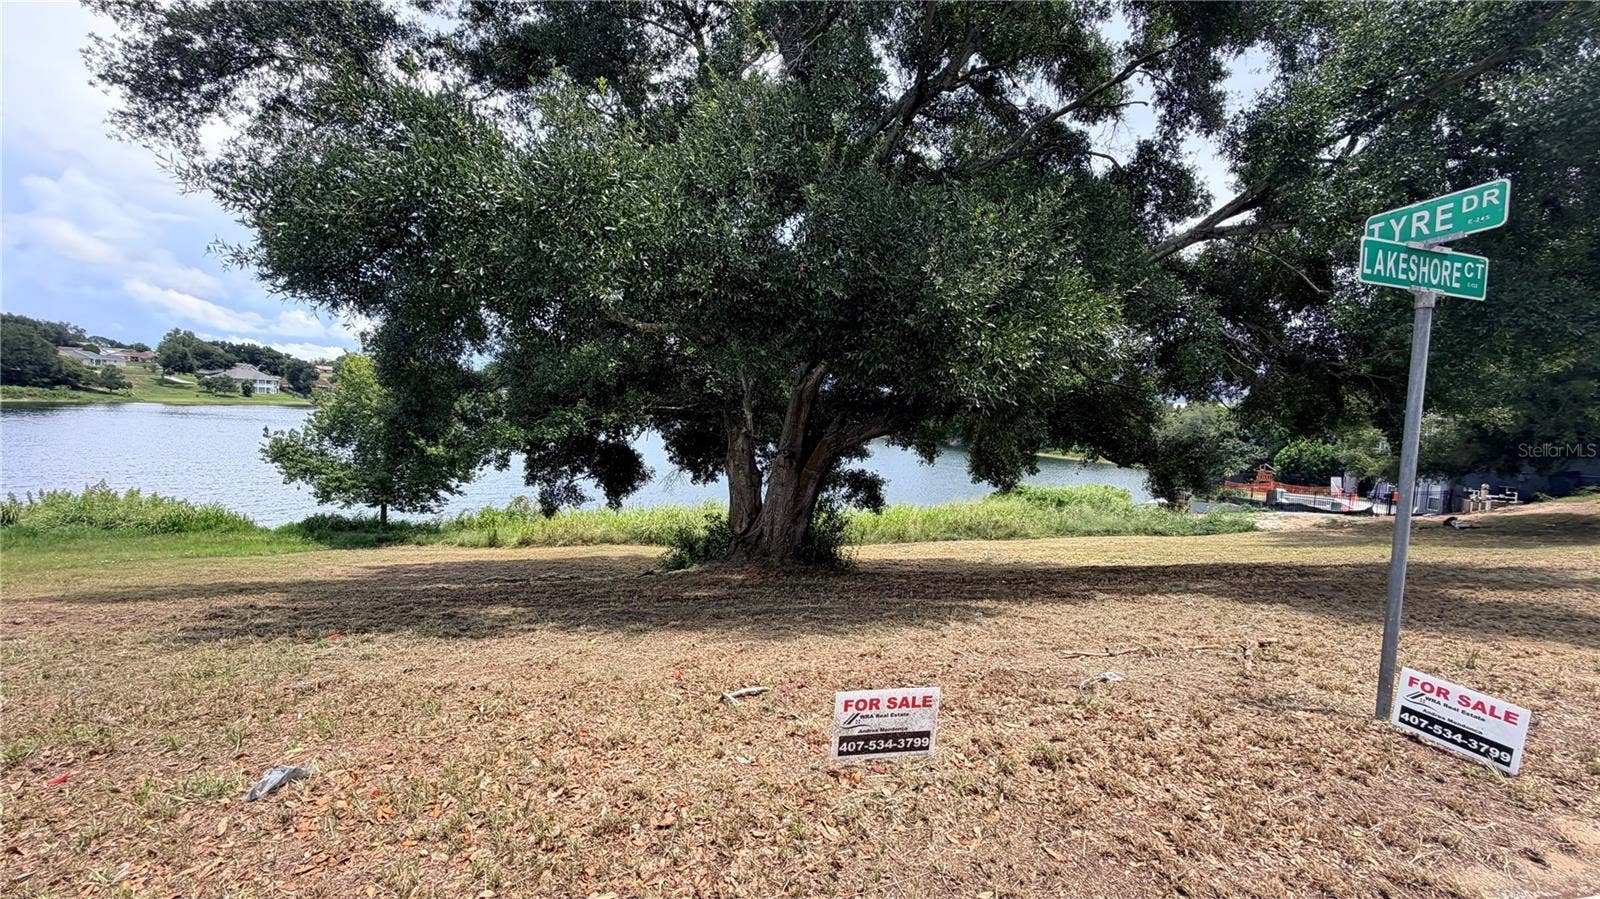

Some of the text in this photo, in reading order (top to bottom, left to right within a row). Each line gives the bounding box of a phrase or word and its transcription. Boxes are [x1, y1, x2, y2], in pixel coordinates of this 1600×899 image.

[1369, 189, 1500, 242] TYRE DR
[1363, 247, 1485, 288] LAKESHORE CT
[843, 695, 933, 712] FOR SALE
[1408, 676, 1520, 726] FOR SALE
[1425, 696, 1486, 722] WRA Real Estate
[840, 737, 930, 753] 407-534-3799
[1400, 712, 1511, 763] 407-534-3799
